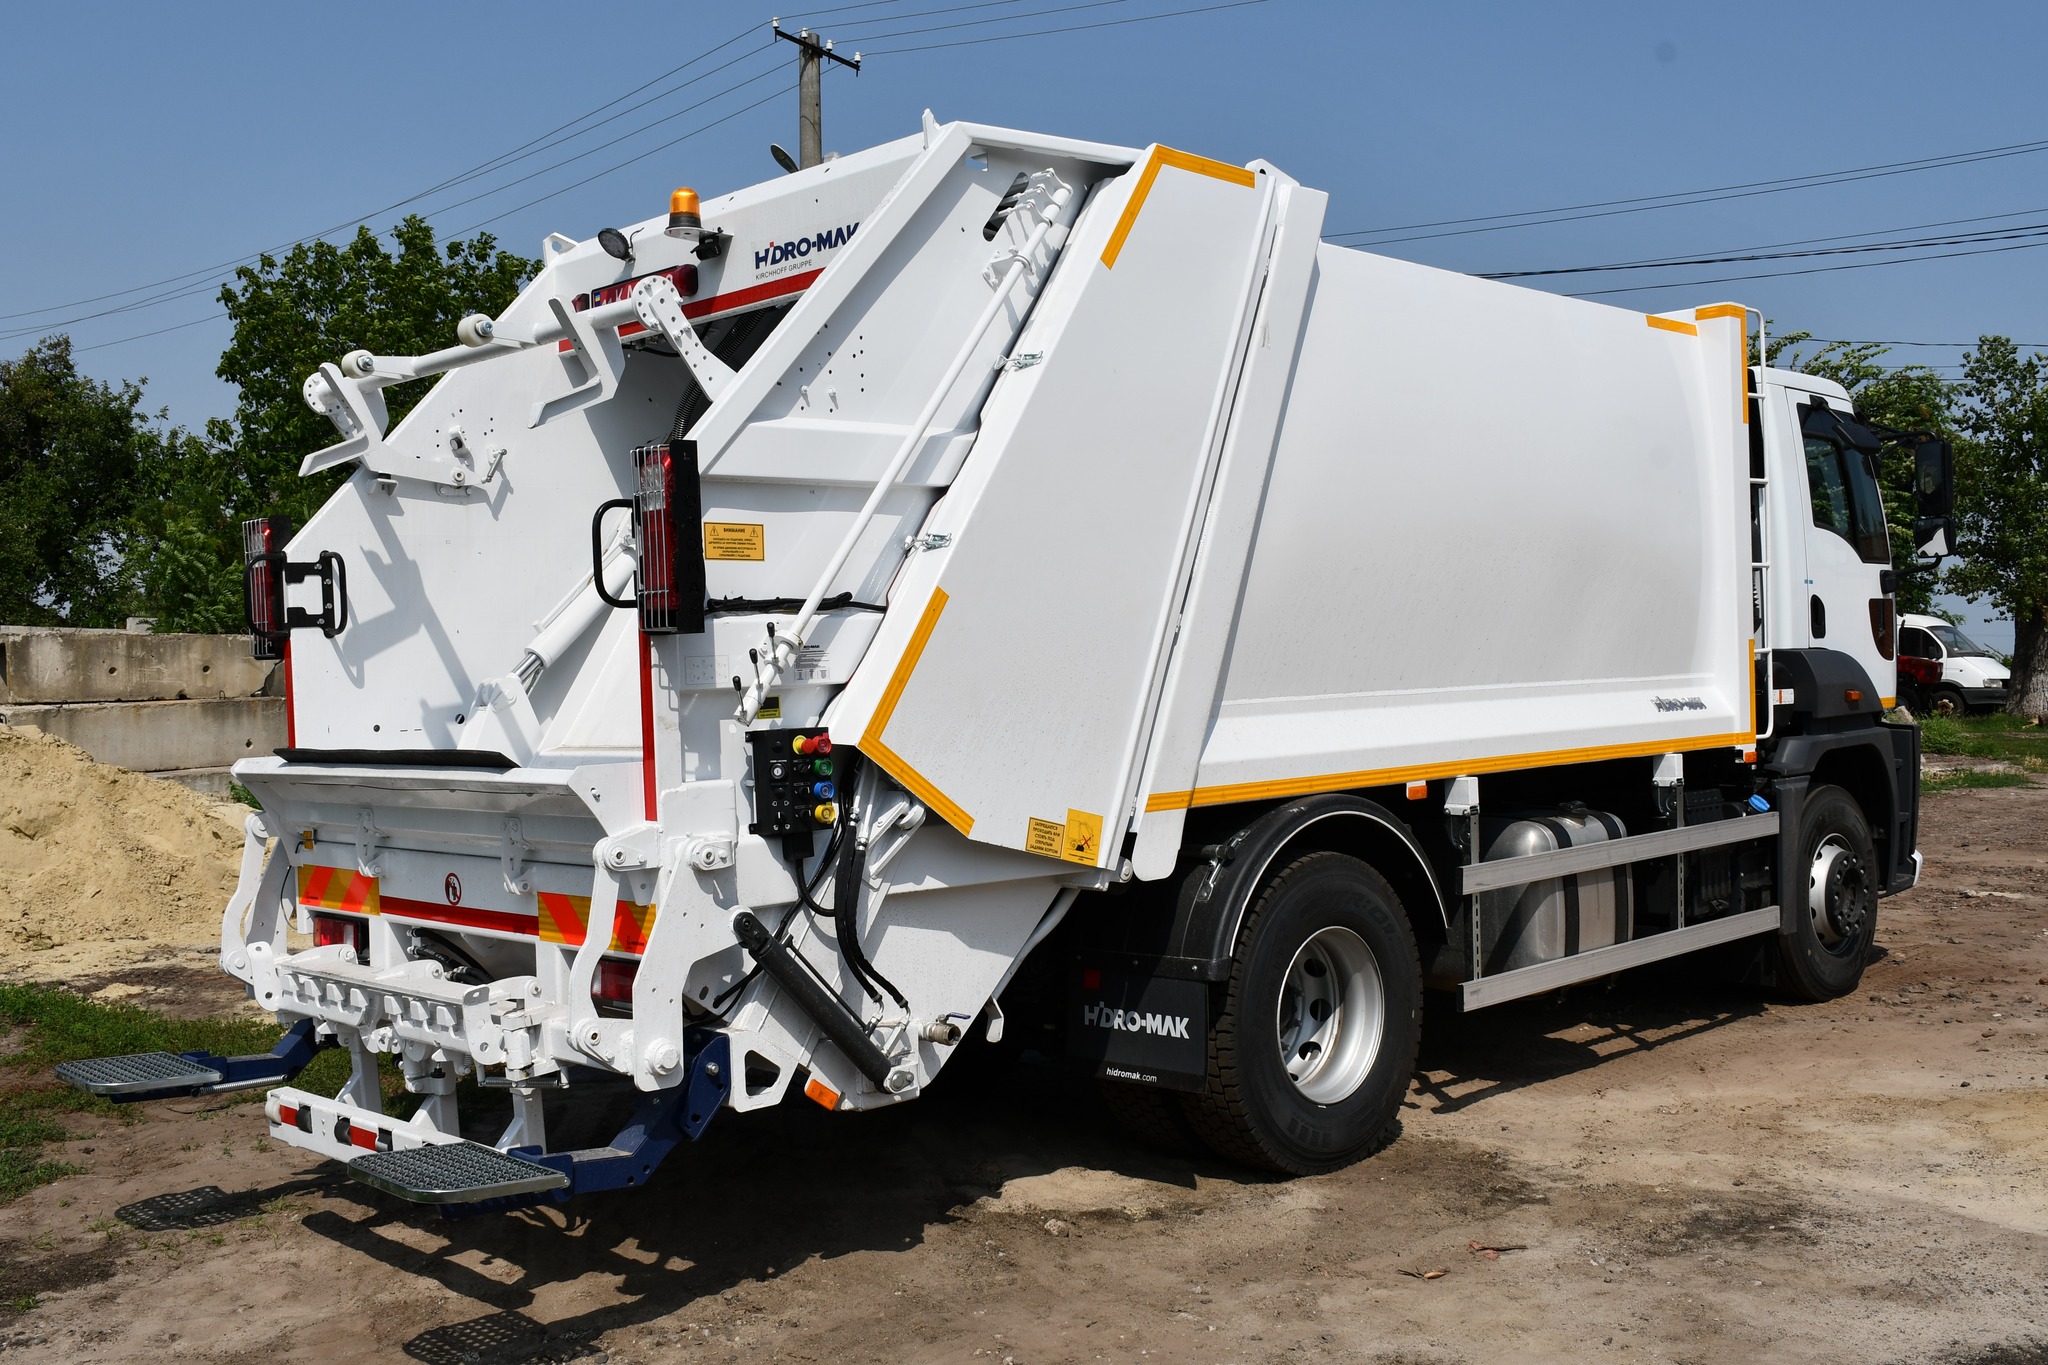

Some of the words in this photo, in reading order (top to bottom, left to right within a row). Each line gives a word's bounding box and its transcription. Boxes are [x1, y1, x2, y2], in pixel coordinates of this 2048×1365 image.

[756, 266, 787, 281] KIRCHHOFF
[788, 259, 812, 272] GRUPPE
[1106, 1067, 1157, 1083] hidromak.com
